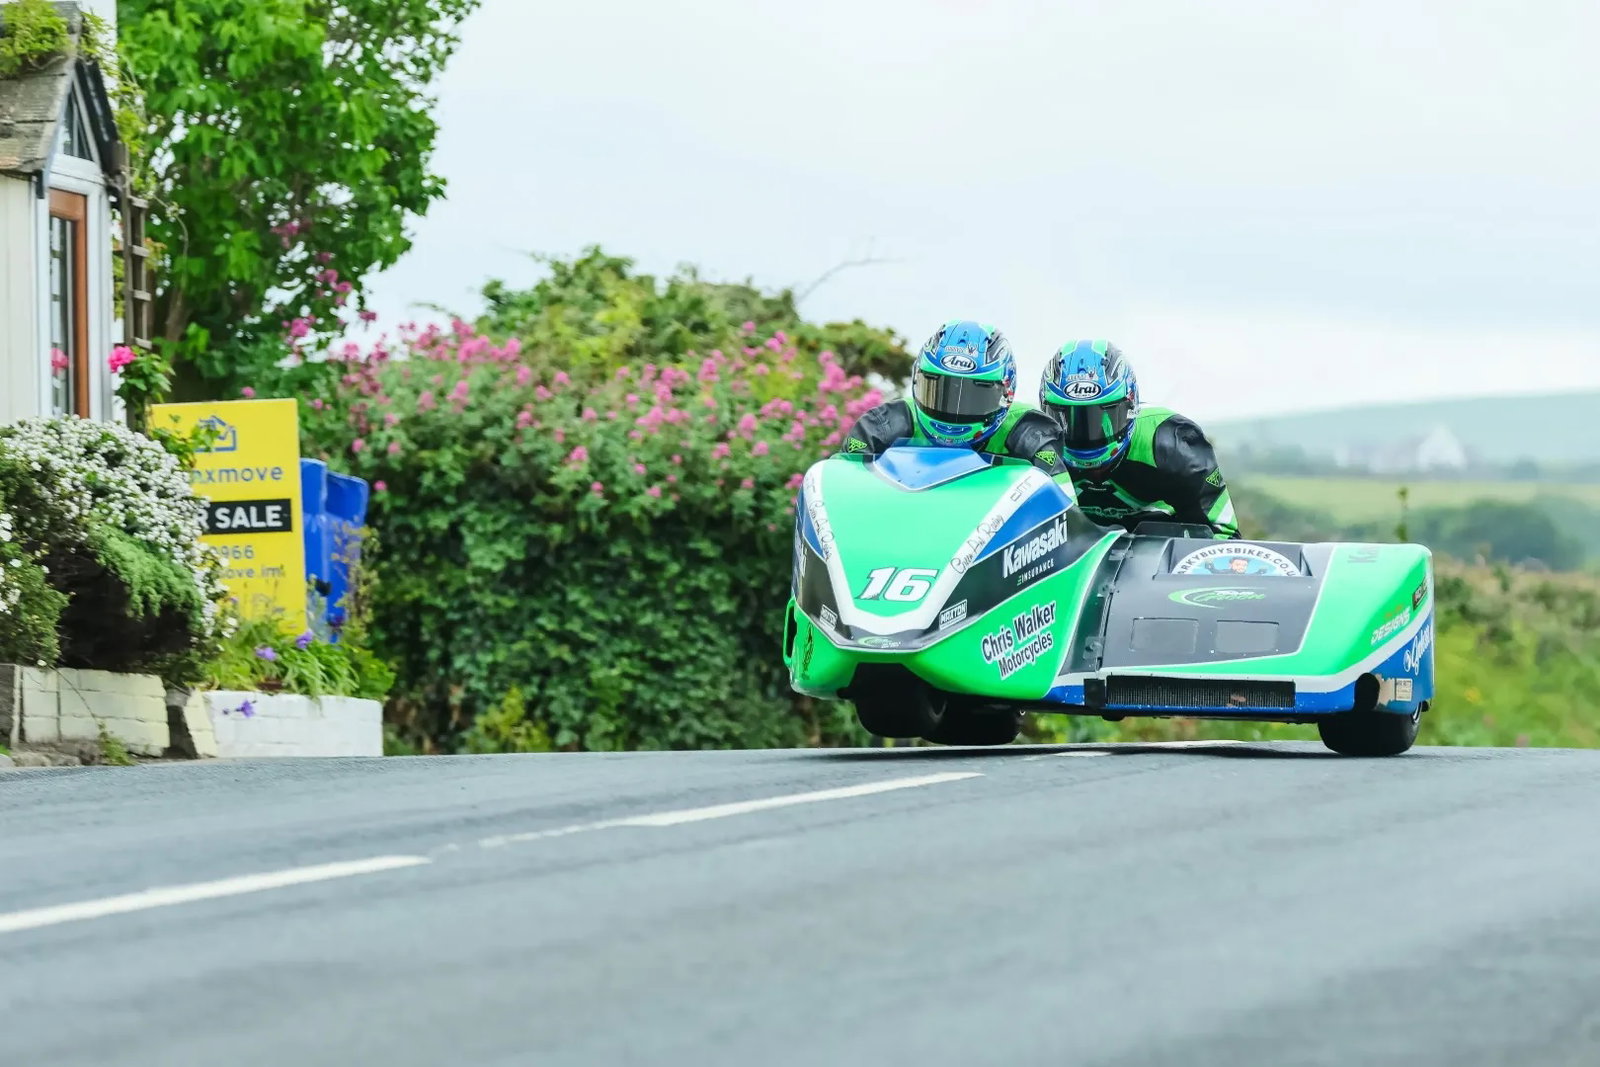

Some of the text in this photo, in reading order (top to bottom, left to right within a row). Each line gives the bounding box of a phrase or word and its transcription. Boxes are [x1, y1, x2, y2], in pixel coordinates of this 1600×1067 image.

[944, 356, 972, 369] Arai
[1069, 384, 1097, 395] Arai
[191, 466, 283, 482] nxmove
[215, 505, 283, 529] SALE
[1003, 512, 1068, 579] Kawasaki
[1021, 558, 1055, 583] INSURANCE
[855, 567, 939, 601] 16
[940, 602, 967, 625] MAXTON
[982, 602, 1056, 662] Chris Walker
[998, 631, 1053, 678] Motorcycles
